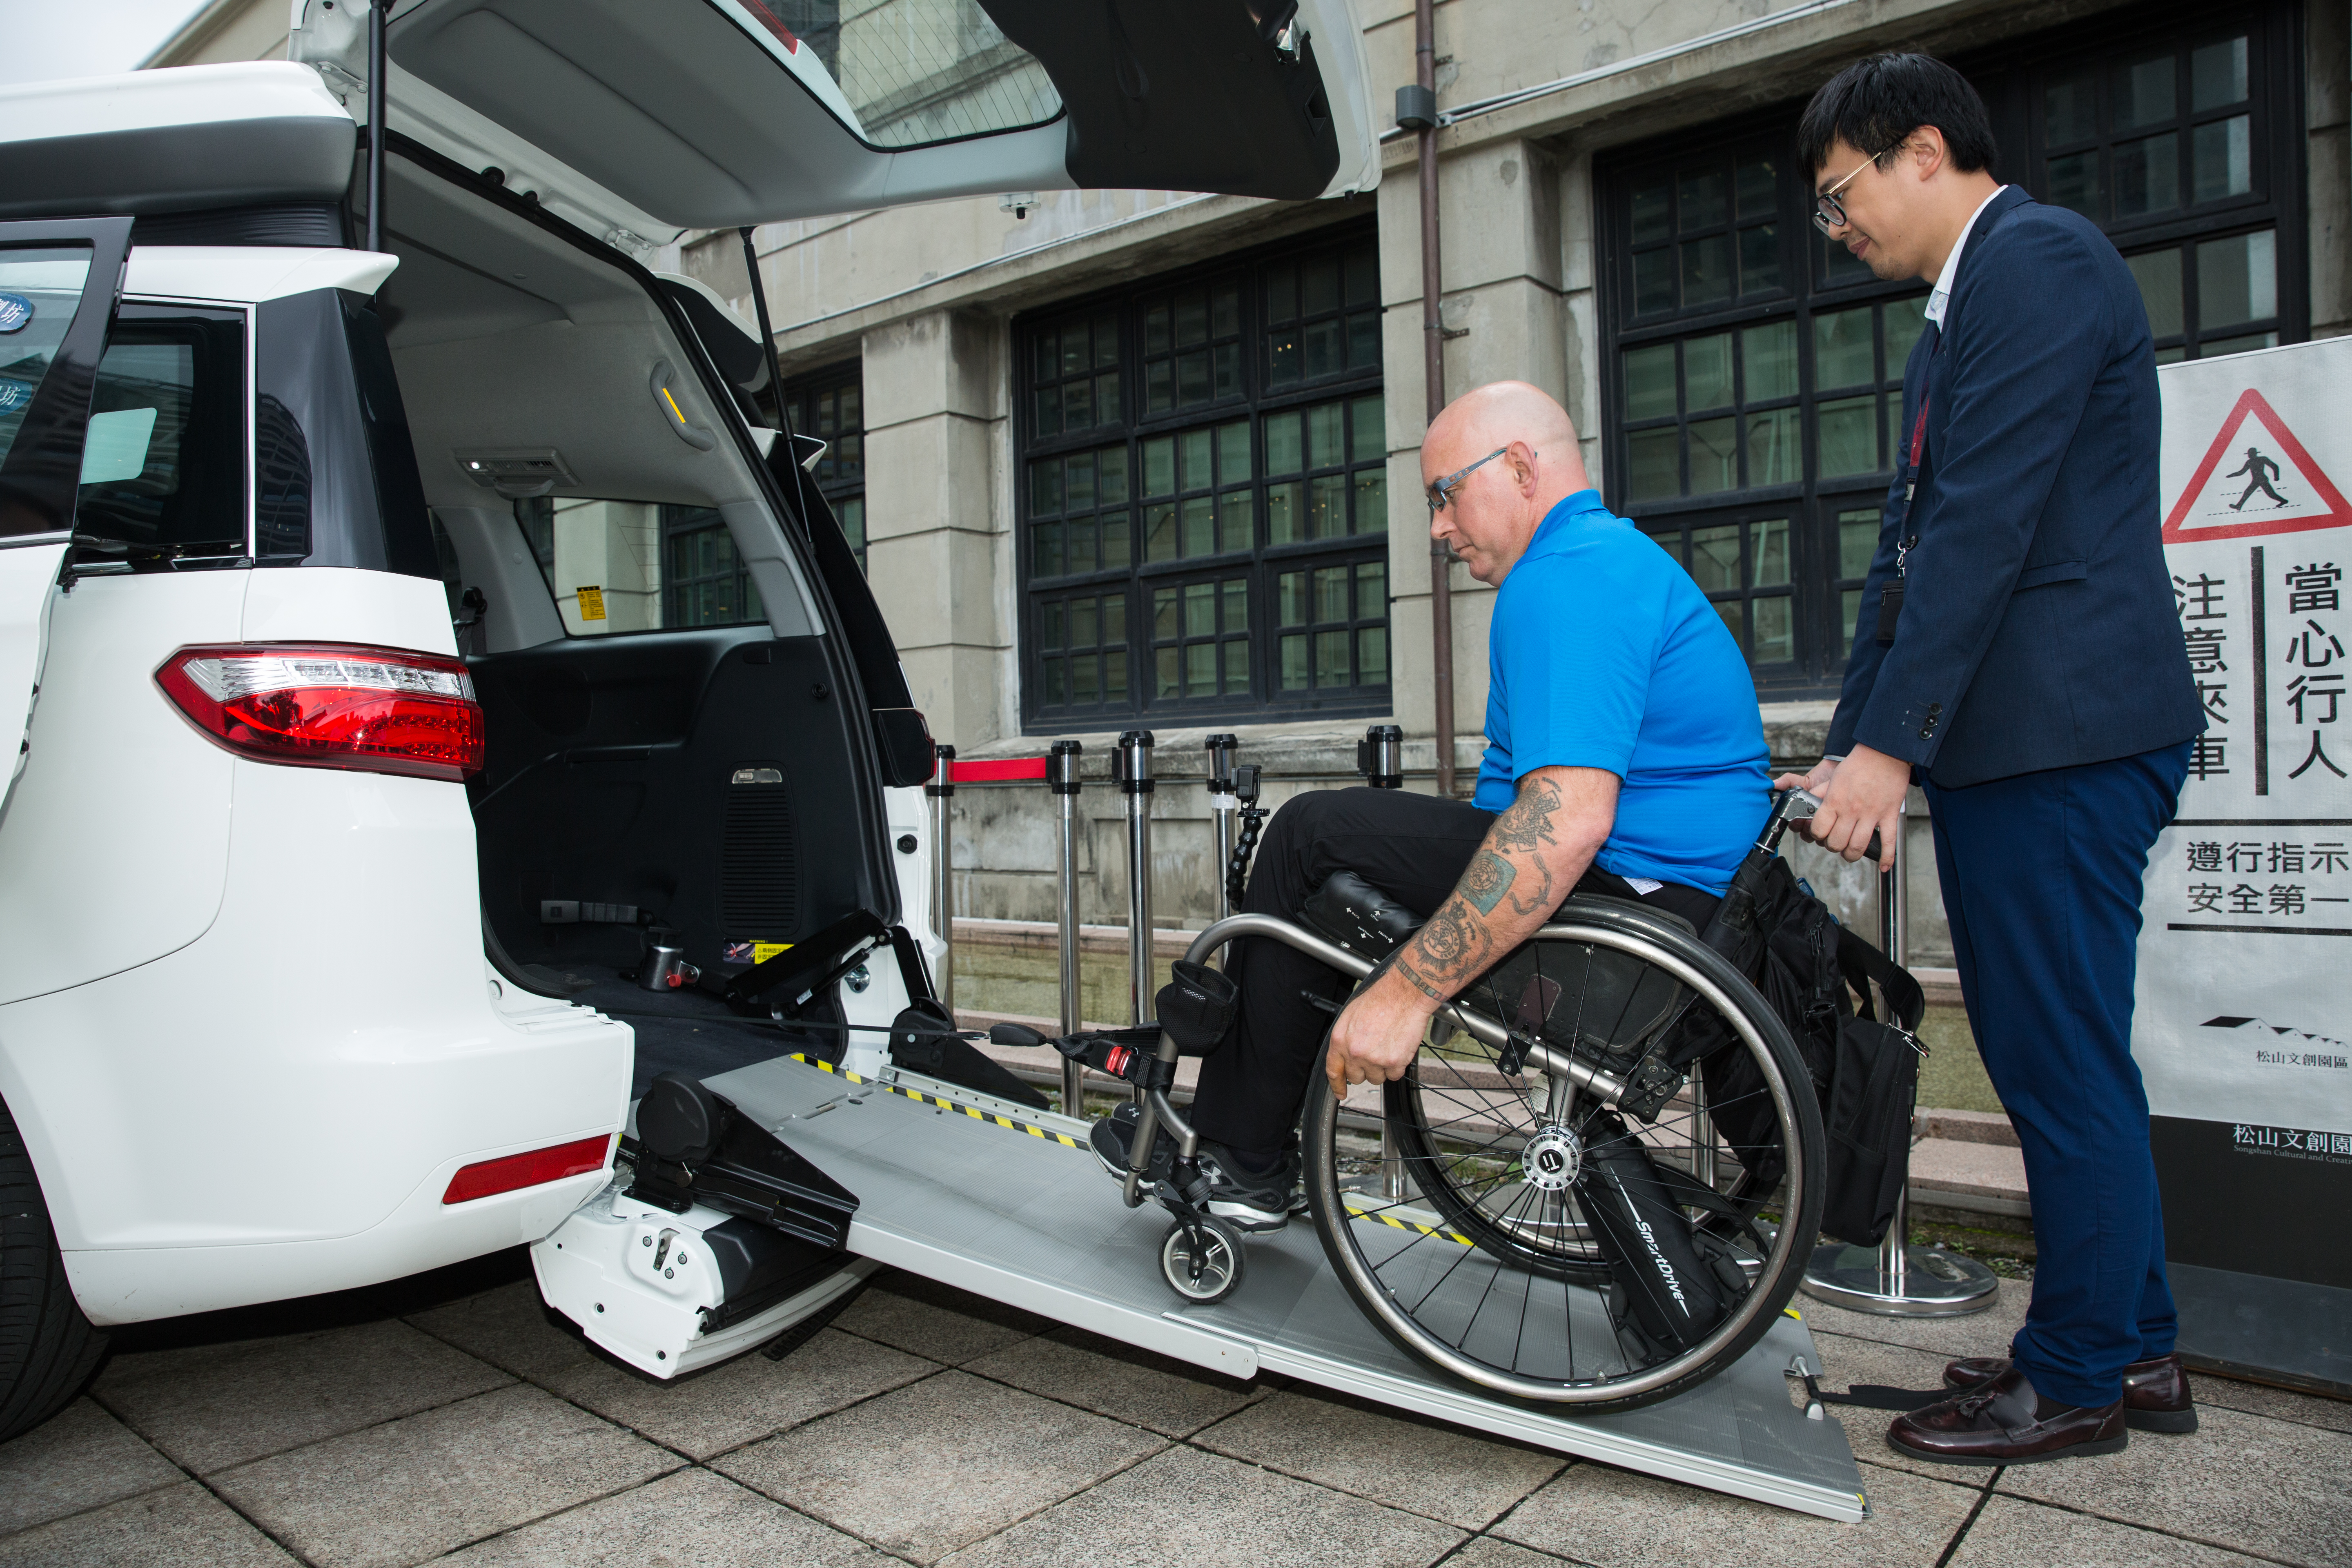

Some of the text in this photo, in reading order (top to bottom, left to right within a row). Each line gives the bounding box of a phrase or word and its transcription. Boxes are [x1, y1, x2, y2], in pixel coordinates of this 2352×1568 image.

[2285, 562, 2348, 780] 當心行人
[2187, 842, 2350, 874] 遵行指示
[2187, 882, 2350, 915] 安全第一
[1378, 931, 1388, 939] FRONT
[2256, 1050, 2349, 1069] 松山文創園區
[2234, 1145, 2272, 1155] Songshan
[2274, 1149, 2306, 1159] Cultural
[1635, 1222, 1685, 1299] SmartDrive
